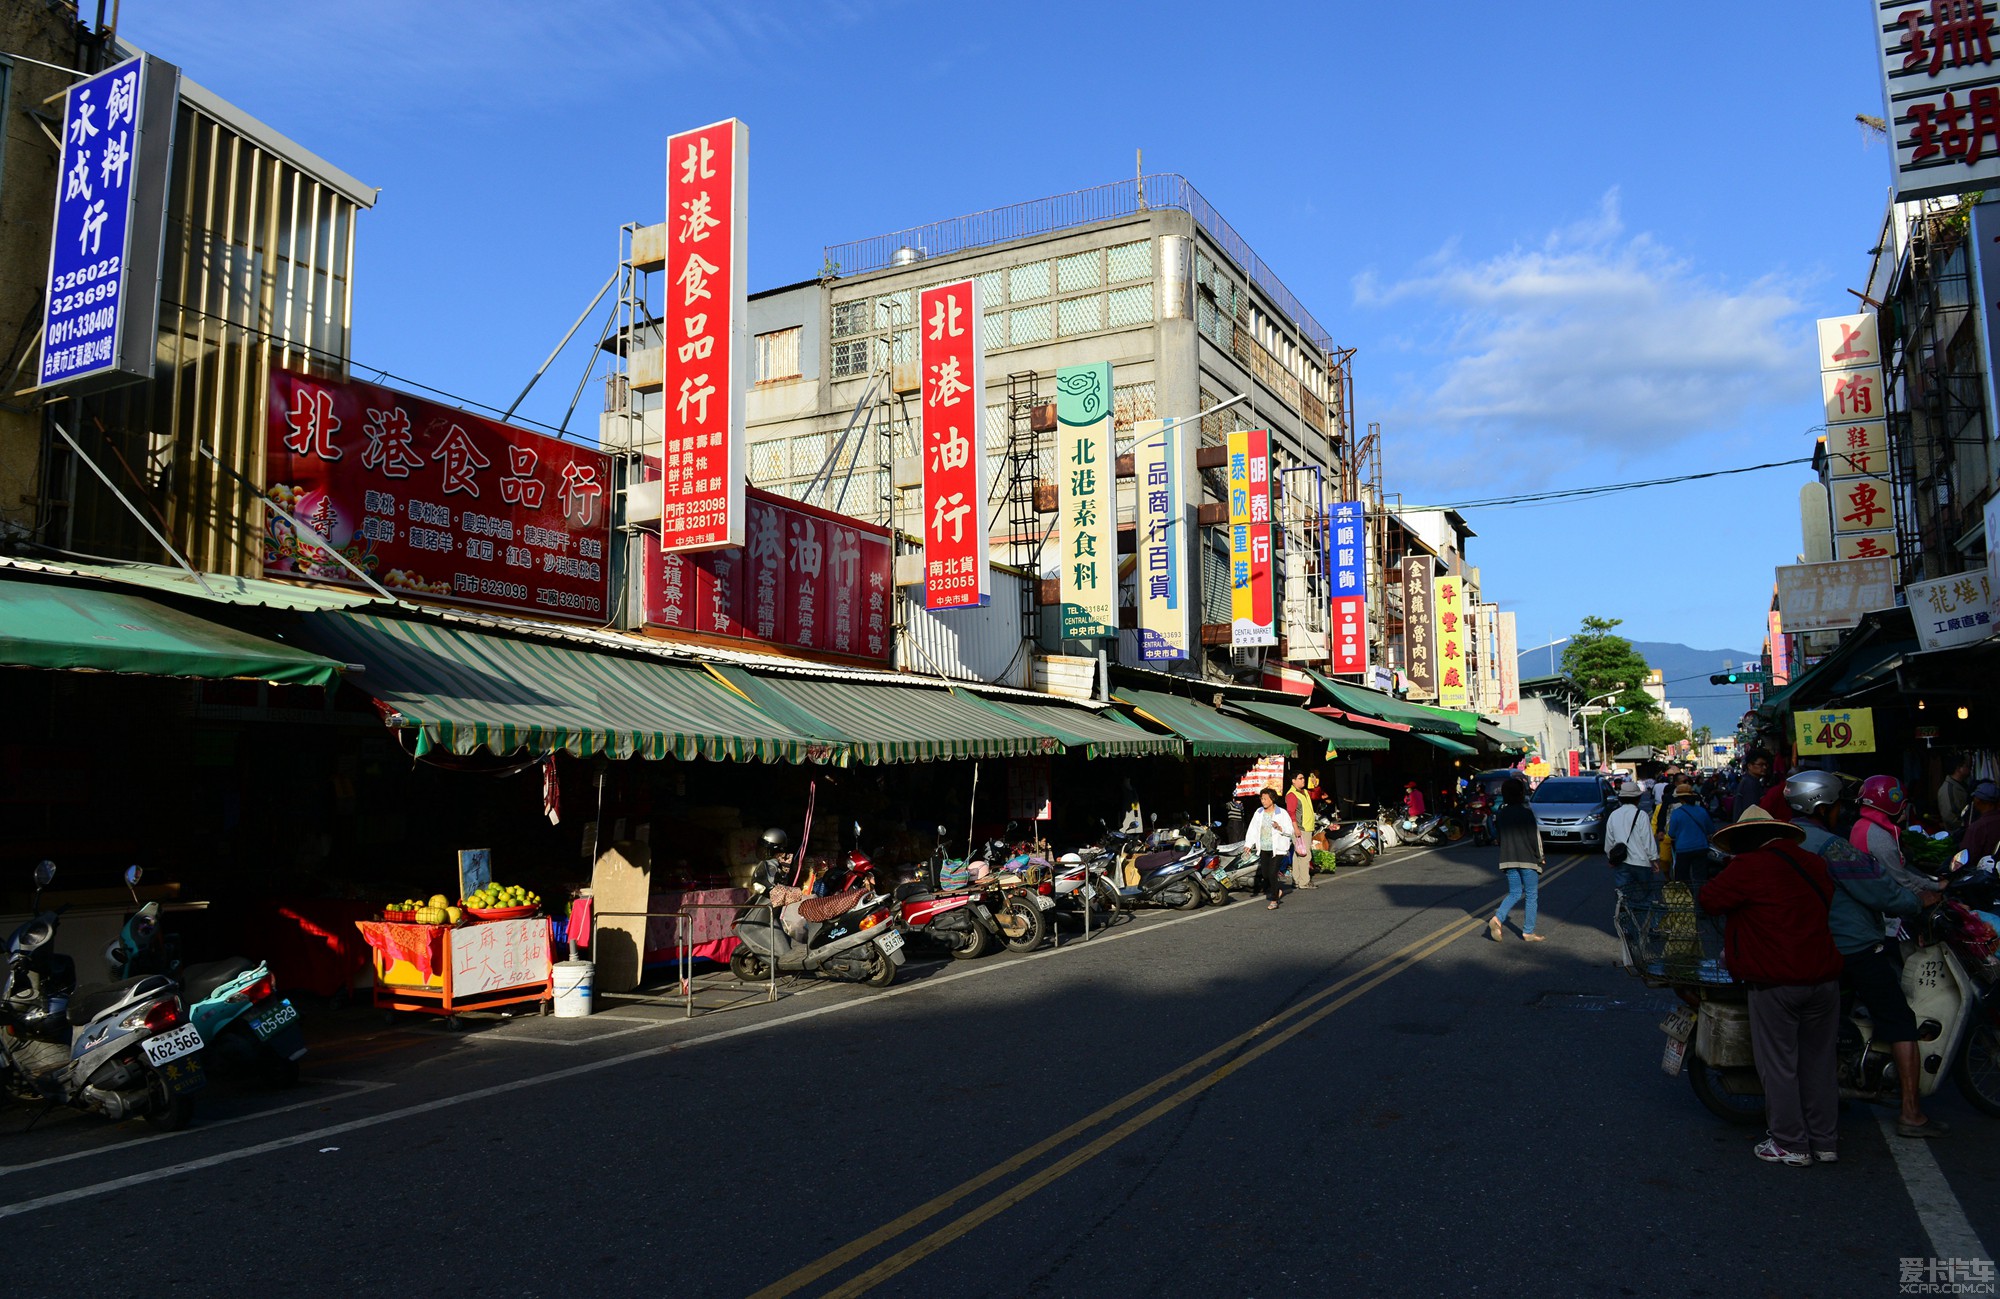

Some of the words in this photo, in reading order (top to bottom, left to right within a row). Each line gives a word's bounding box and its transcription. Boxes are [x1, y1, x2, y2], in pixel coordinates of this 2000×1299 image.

[65, 88, 99, 203] 永成
[100, 70, 137, 189] 飼料
[79, 199, 109, 256] 行
[54, 256, 120, 293] 326022
[675, 137, 720, 425] 北港食品行
[51, 279, 117, 316] 323699
[49, 306, 114, 346] 0911-338408
[44, 336, 112, 378] 台東市正氣路249號
[929, 294, 971, 544] 北港油行
[283, 389, 603, 526] 北港食品行
[1071, 438, 1098, 591] 北港素食料
[1147, 441, 1170, 600] 一品商行百貨
[1231, 452, 1249, 590] 泰欣童裝
[1249, 456, 1269, 564] 明泰行
[675, 533, 716, 546] 中央市場
[929, 556, 974, 577] 南北貨
[929, 575, 975, 591] 323055
[936, 593, 969, 606] 中央市場
[1069, 625, 1105, 637] 中央市場
[1146, 649, 1178, 658] 中央市場
[1816, 722, 1852, 748] 49
